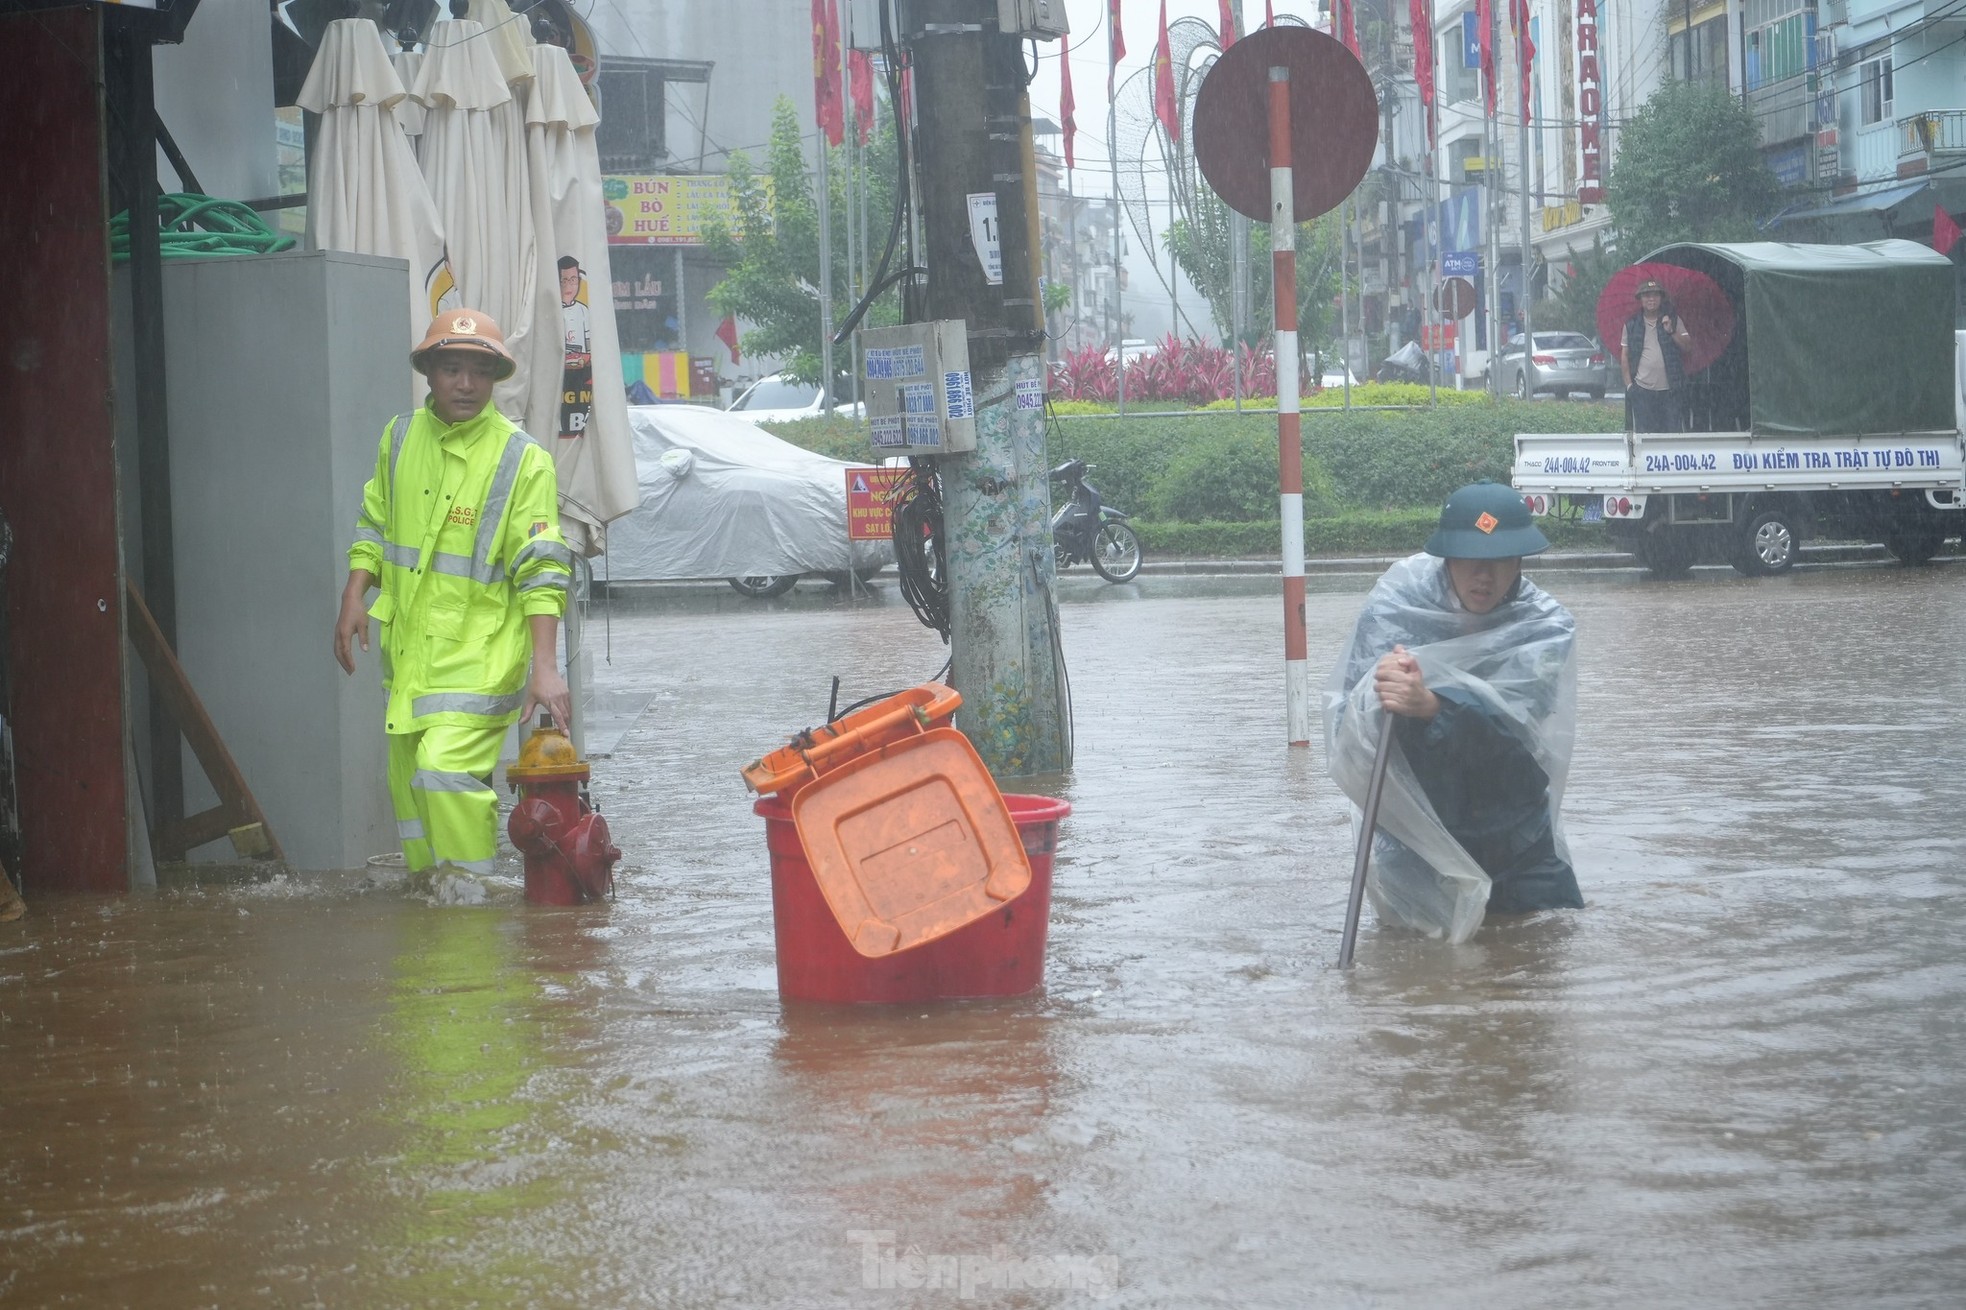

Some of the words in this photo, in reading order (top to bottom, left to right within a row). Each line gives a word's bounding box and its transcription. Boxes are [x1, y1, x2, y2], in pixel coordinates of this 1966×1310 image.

[634, 179, 669, 194] BÚN
[641, 197, 663, 213] BÒ
[634, 214, 670, 232] HUẾ
[1445, 261, 1461, 269] ATM
[1646, 454, 1716, 472] 24A-004.42
[1762, 447, 1799, 469] KIỂM
[1803, 452, 1831, 468] TRA
[1834, 448, 1869, 470] TRẬT
[1873, 449, 1891, 470] TỰ
[1895, 448, 1914, 467] ĐÔ
[1918, 450, 1940, 469] THỊ
[447, 515, 475, 526] POLICE
[852, 508, 868, 518] KHU
[870, 507, 884, 519] VỰC
[865, 523, 879, 535] SẠT
